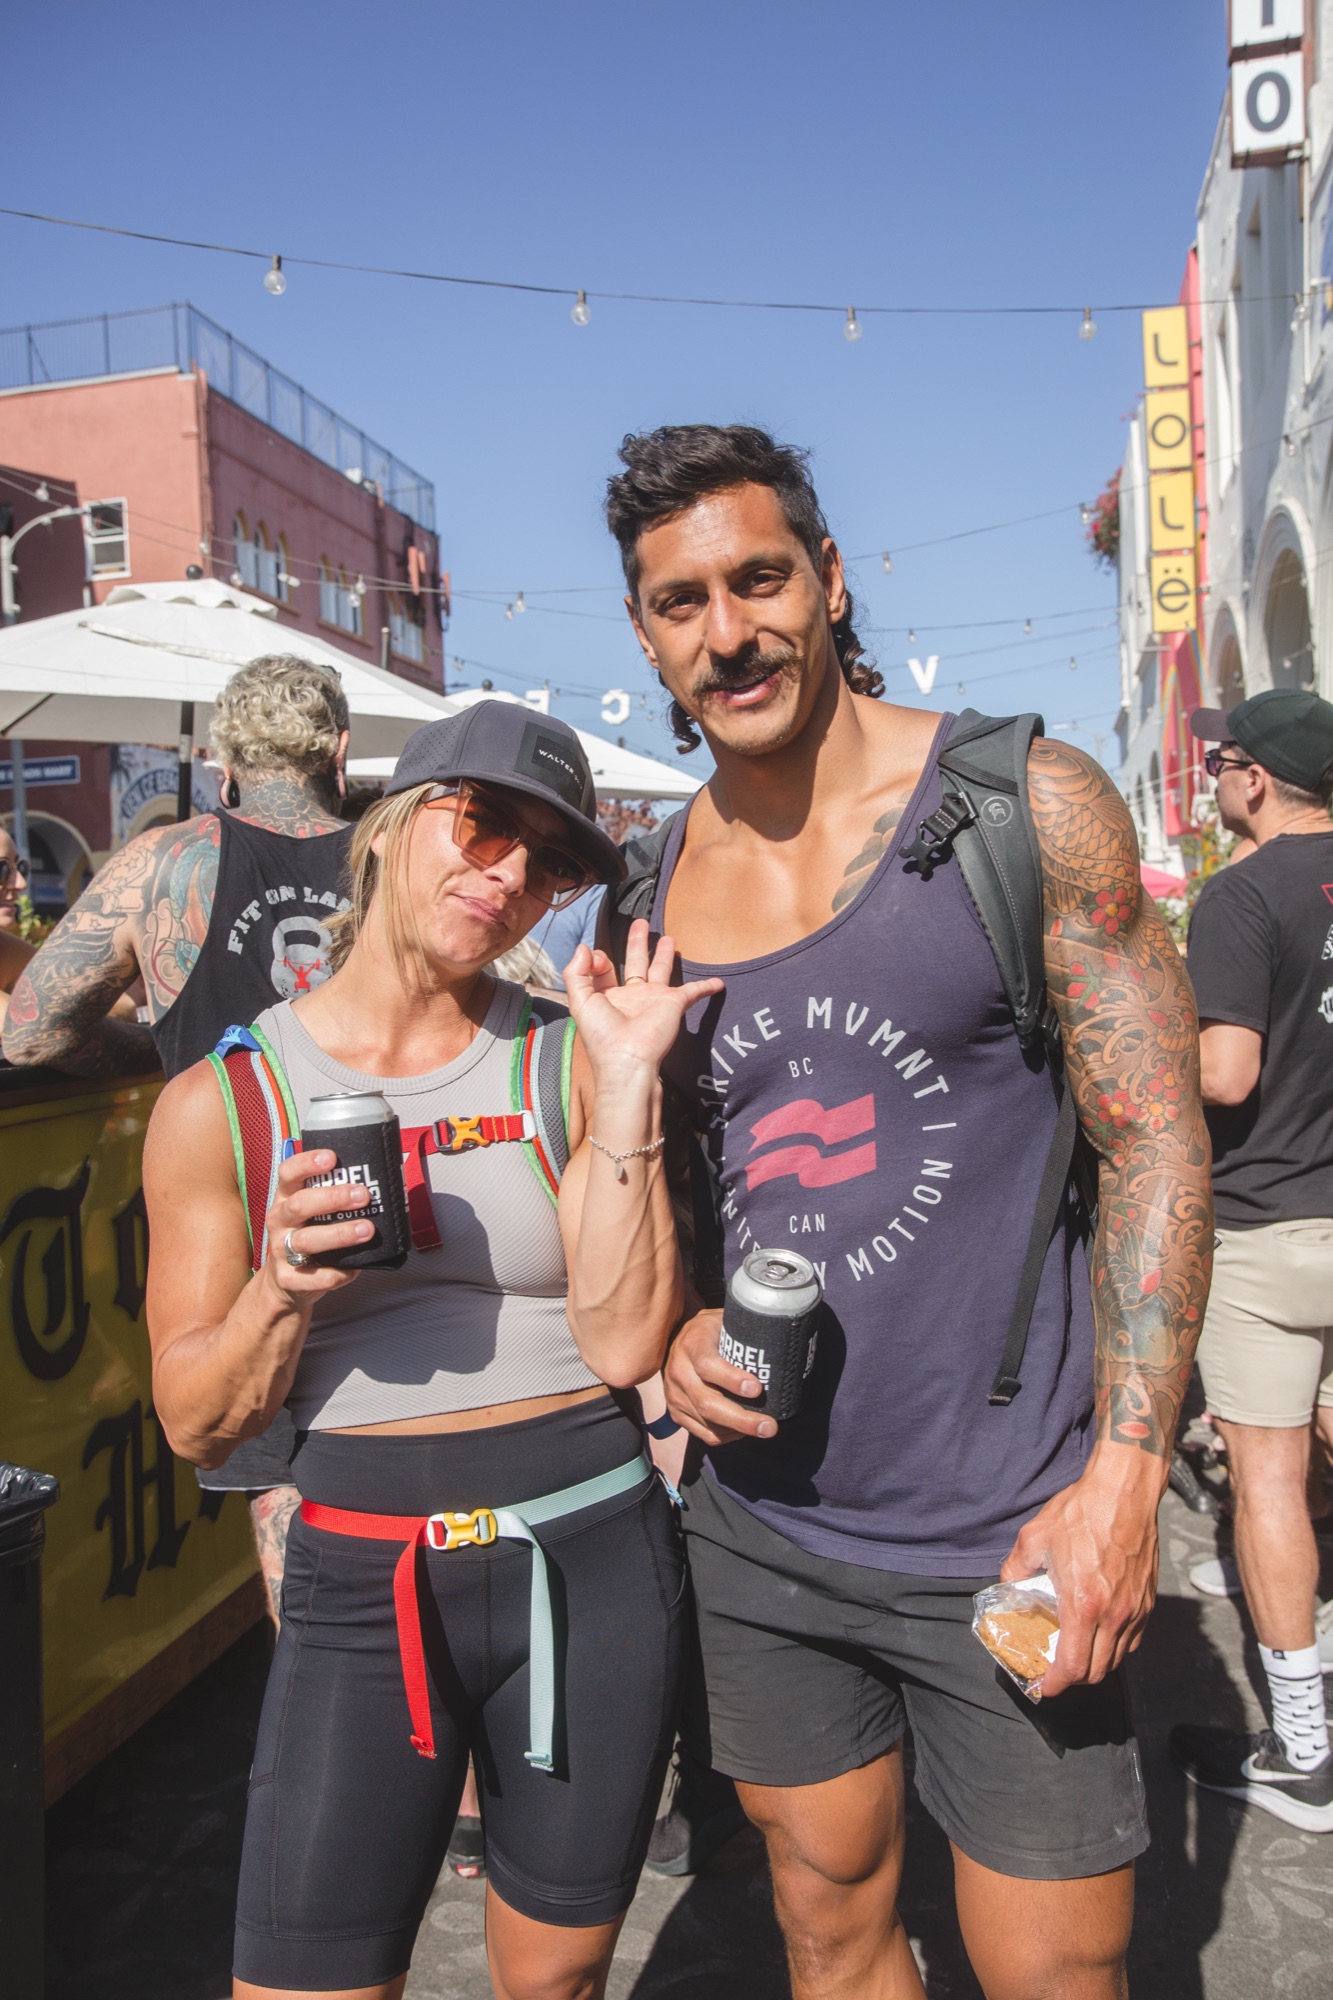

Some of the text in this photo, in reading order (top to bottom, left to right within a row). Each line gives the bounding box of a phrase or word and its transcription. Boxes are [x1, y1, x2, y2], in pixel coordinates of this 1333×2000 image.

[538, 748, 575, 774] WALTER
[227, 899, 262, 955] FIT
[265, 885, 297, 905] ON
[806, 996, 950, 1099] MVMNT
[788, 1057, 813, 1078] BC
[337, 1204, 385, 1220] OUTSIDE
[789, 1213, 826, 1233] CAN
[845, 1158, 953, 1281] MOTION
